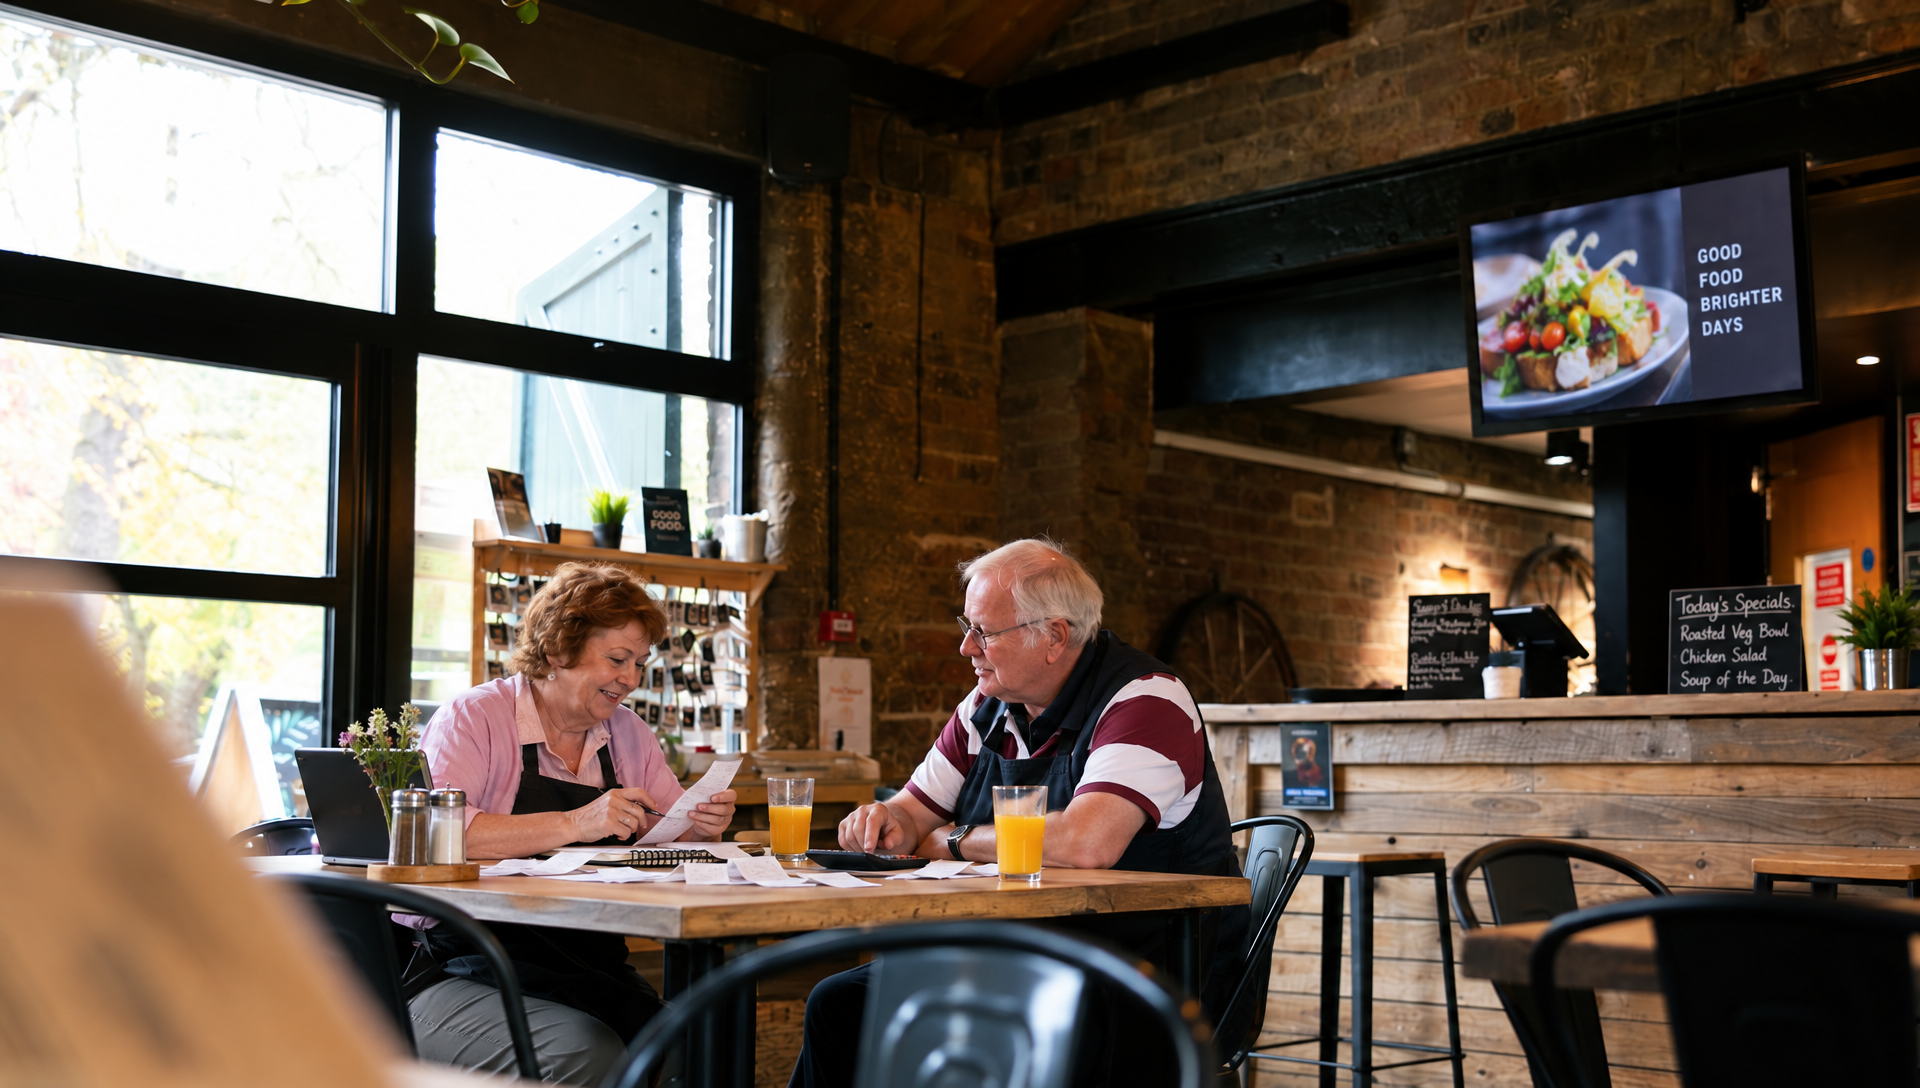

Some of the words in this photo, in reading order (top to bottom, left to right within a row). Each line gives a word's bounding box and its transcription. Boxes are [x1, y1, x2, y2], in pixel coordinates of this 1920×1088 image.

[1697, 243, 1742, 264] GOOD
[1699, 267, 1743, 288] FOOD
[1700, 286, 1783, 312] BRIGHTER
[1701, 316, 1744, 336] DAYS
[1675, 594, 1729, 622] Today's
[1680, 624, 1726, 642] Roasted
[1731, 623, 1753, 645] Veg
[1758, 622, 1790, 639] Bowl
[1680, 647, 1726, 665] Chicken
[1731, 645, 1768, 663] Salad
[1680, 670, 1711, 692] Soup
[1716, 670, 1731, 689] of
[1736, 670, 1757, 685] the
